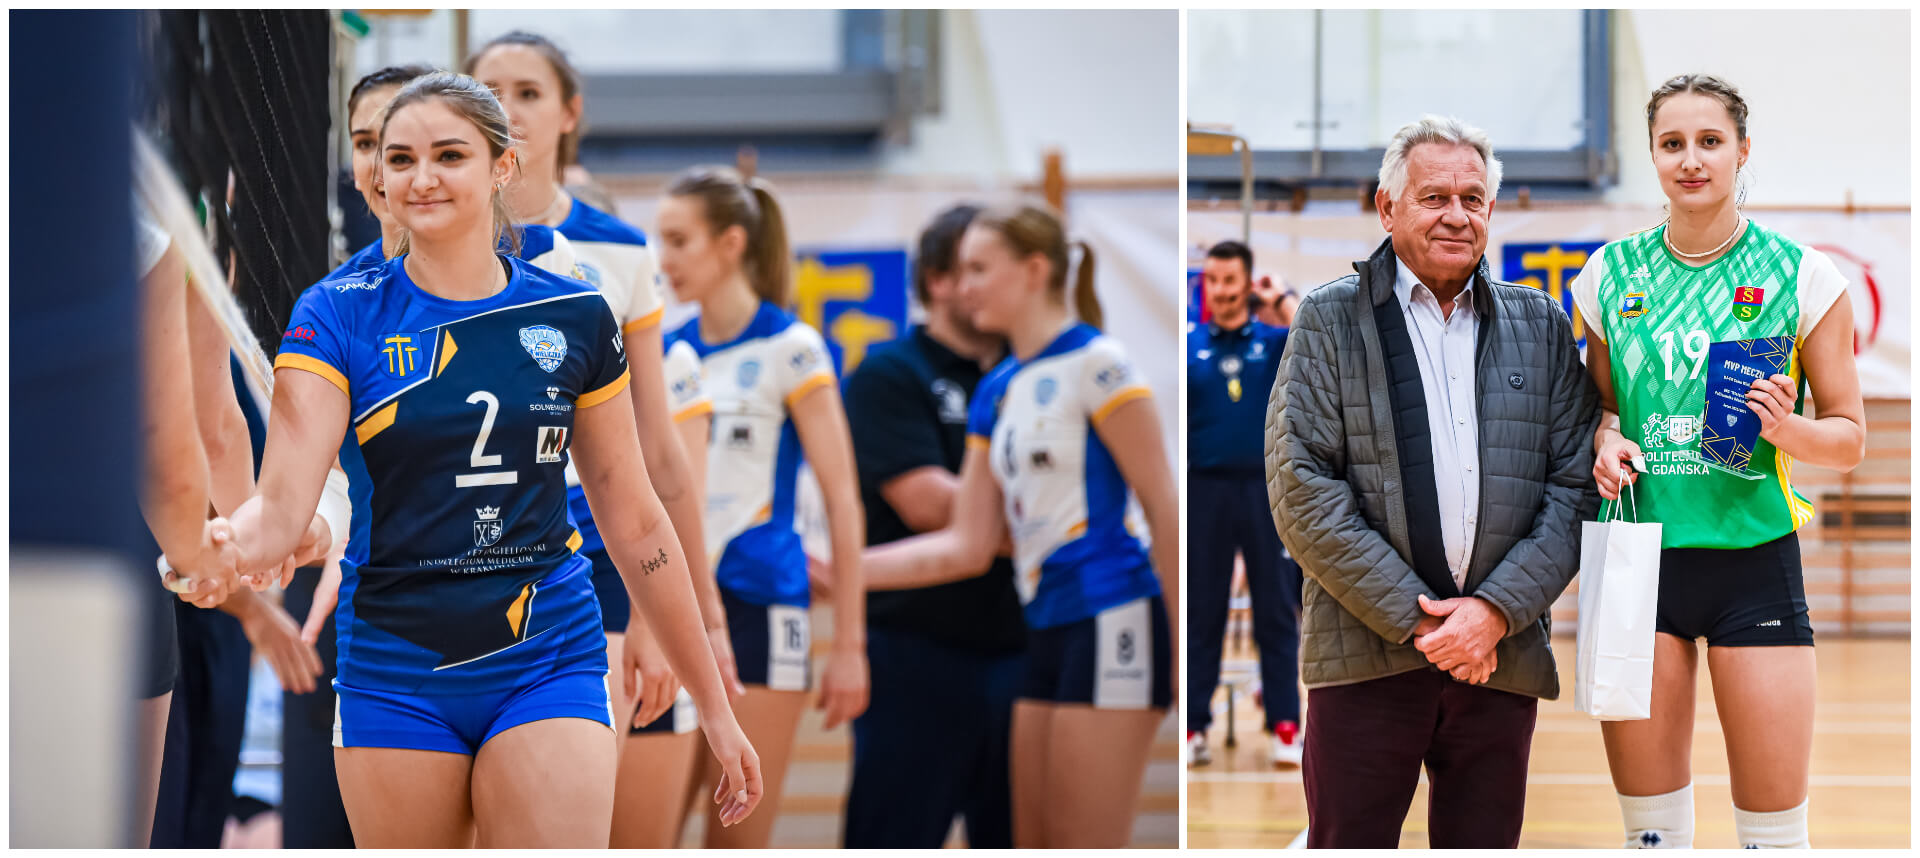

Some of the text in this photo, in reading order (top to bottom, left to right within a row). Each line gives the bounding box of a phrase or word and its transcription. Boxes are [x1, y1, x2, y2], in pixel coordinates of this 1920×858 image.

[1743, 290, 1754, 302] S
[1740, 306, 1752, 318] S
[1659, 330, 1710, 380] 19
[1723, 359, 1741, 371] MVP
[466, 390, 502, 467] 2
[1652, 462, 1710, 475] GDAŃSKA
